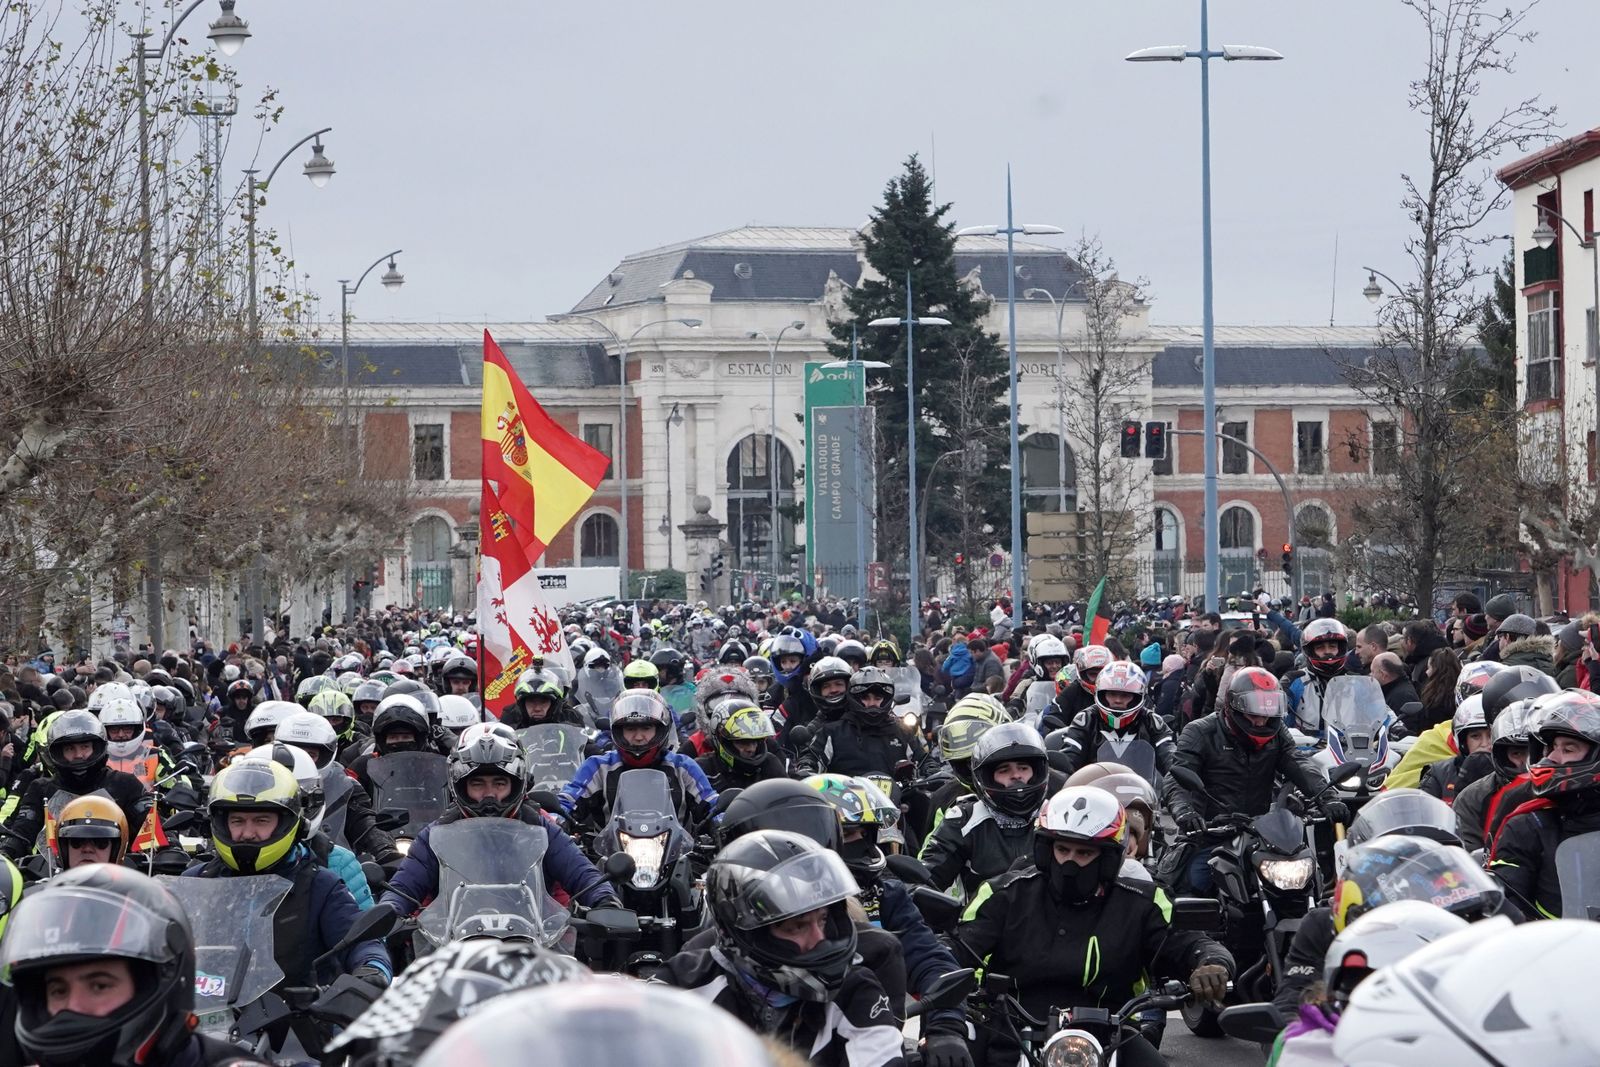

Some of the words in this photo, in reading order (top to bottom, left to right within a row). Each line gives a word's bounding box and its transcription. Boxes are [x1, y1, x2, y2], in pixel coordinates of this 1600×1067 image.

[728, 363, 792, 375] ESTACON
[826, 370, 859, 380] adi
[819, 434, 828, 496] VALLADOLID
[832, 435, 841, 476] GRANDE
[832, 481, 841, 520] CAMPO
